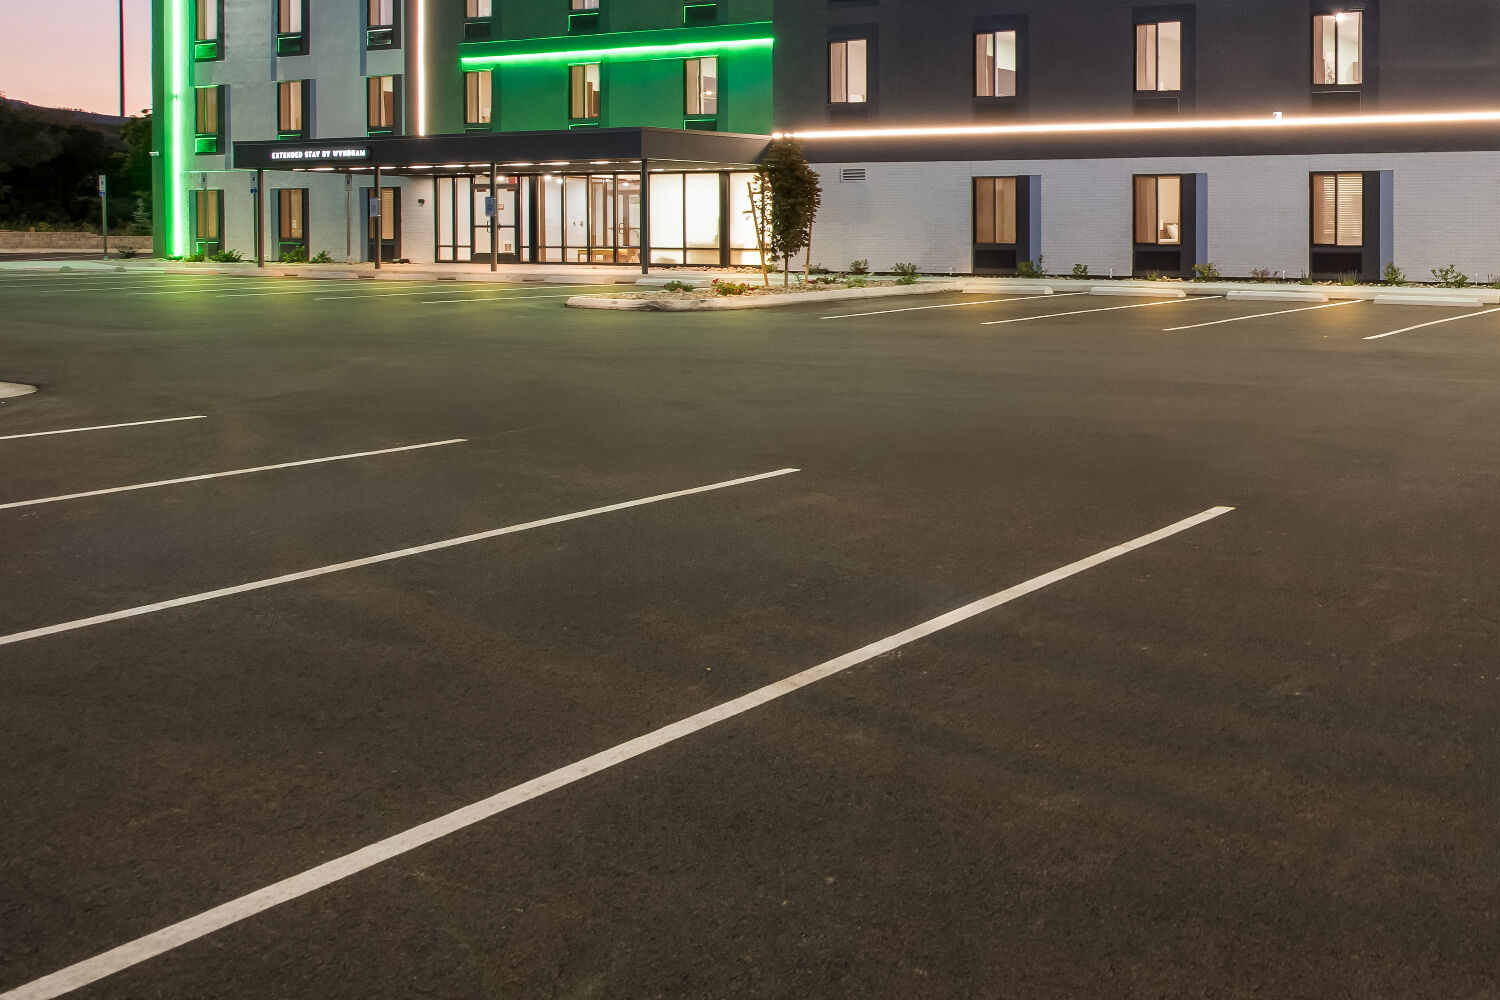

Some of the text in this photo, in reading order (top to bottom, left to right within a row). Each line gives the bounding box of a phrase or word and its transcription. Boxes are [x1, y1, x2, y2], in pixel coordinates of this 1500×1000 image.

[271, 149, 366, 159] EXTENDED STAY BY WYNDHAM
